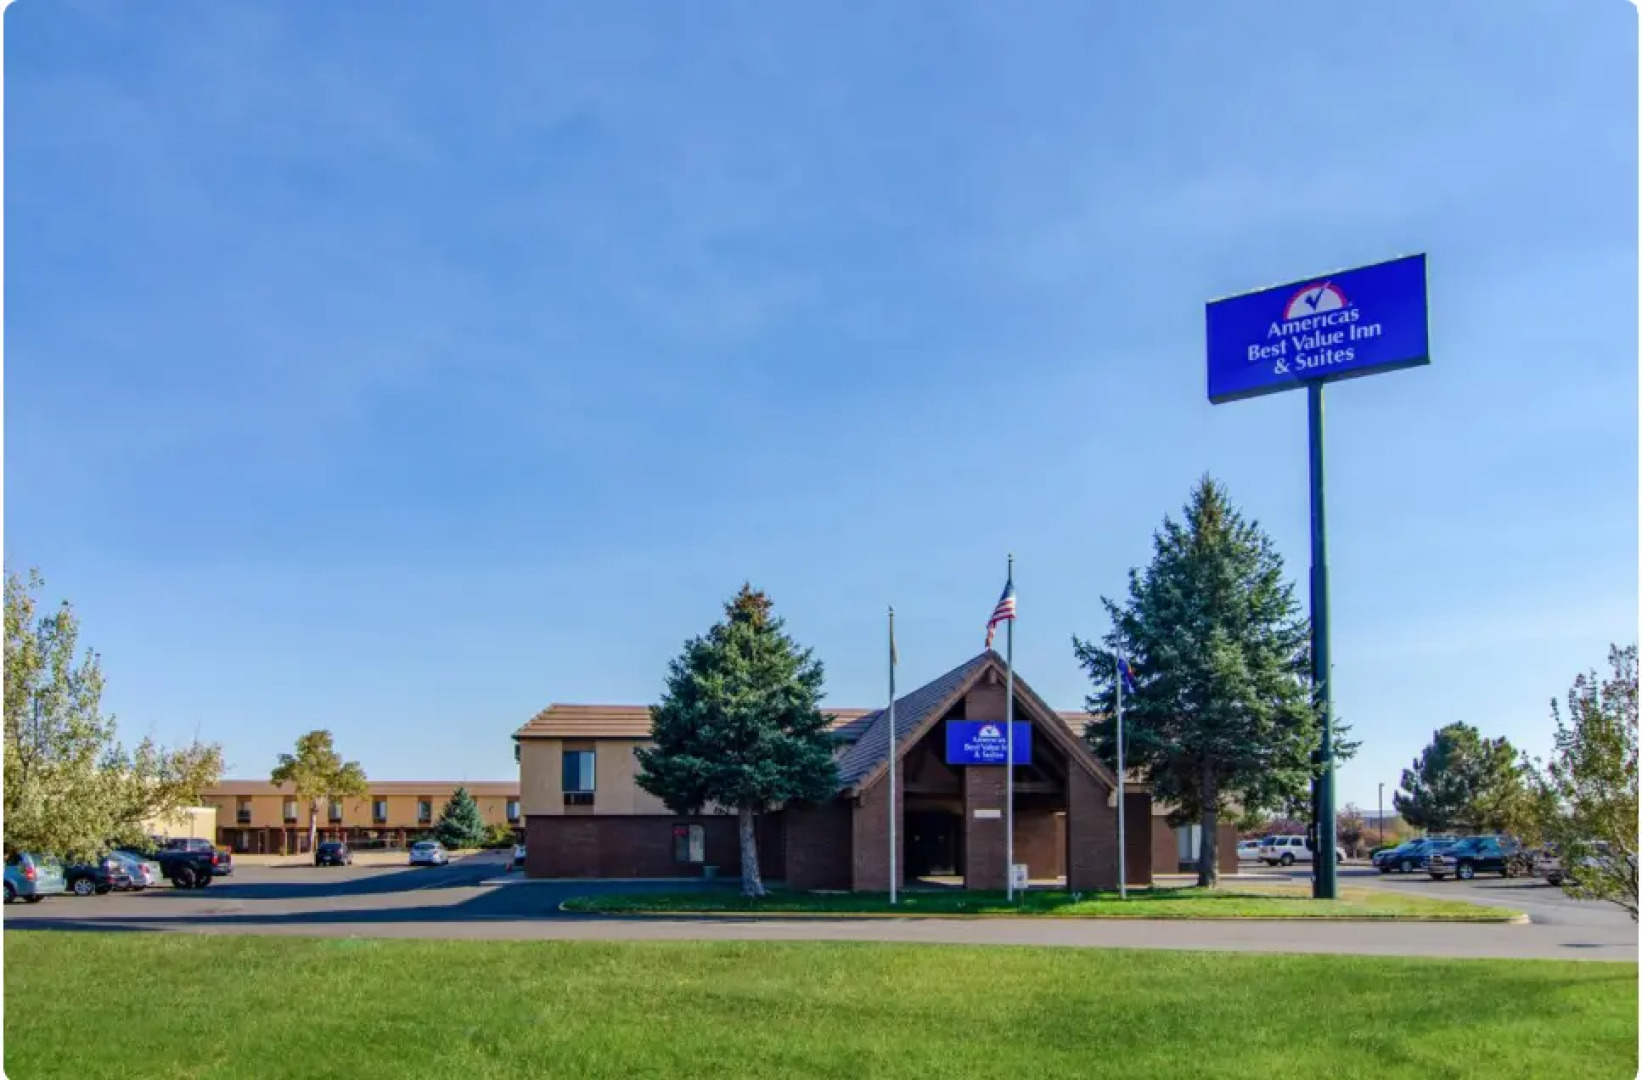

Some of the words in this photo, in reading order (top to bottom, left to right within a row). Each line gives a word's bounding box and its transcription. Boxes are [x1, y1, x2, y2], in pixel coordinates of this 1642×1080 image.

[1268, 308, 1360, 338] Americas
[1247, 341, 1287, 361] Best
[1292, 331, 1344, 350] Value
[1350, 323, 1382, 340] Inn
[1273, 358, 1290, 375] &
[1295, 348, 1355, 371] Suites
